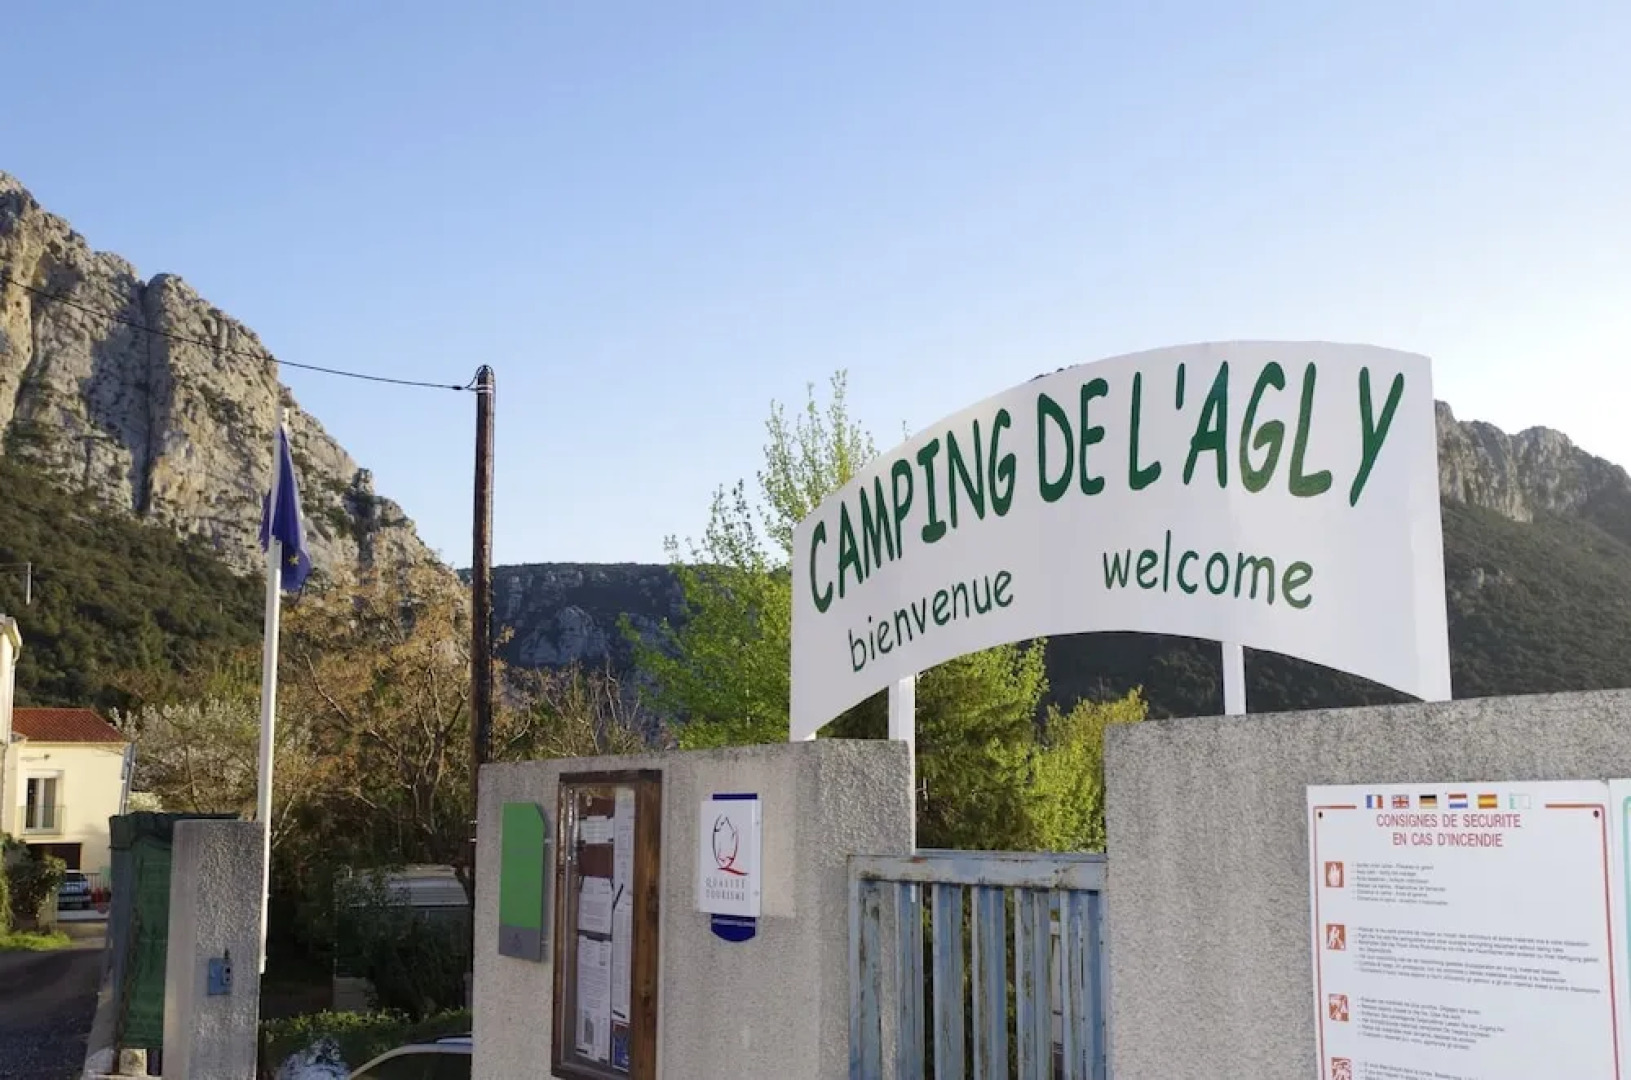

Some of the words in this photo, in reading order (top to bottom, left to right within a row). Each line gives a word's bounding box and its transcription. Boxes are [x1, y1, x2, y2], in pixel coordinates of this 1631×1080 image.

[808, 408, 1017, 613] CAMPING
[1036, 377, 1110, 503] DE
[1129, 361, 1404, 506] L'AGLY
[1103, 530, 1314, 609] welcome
[848, 570, 1014, 672] bienvenue
[1376, 813, 1438, 828] CONSIGNES
[1442, 813, 1458, 828] DE
[1463, 813, 1521, 828] SECURITE
[1392, 832, 1407, 846] EN
[1411, 833, 1433, 846] CAS
[1438, 833, 1503, 847] D'INCENDIE
